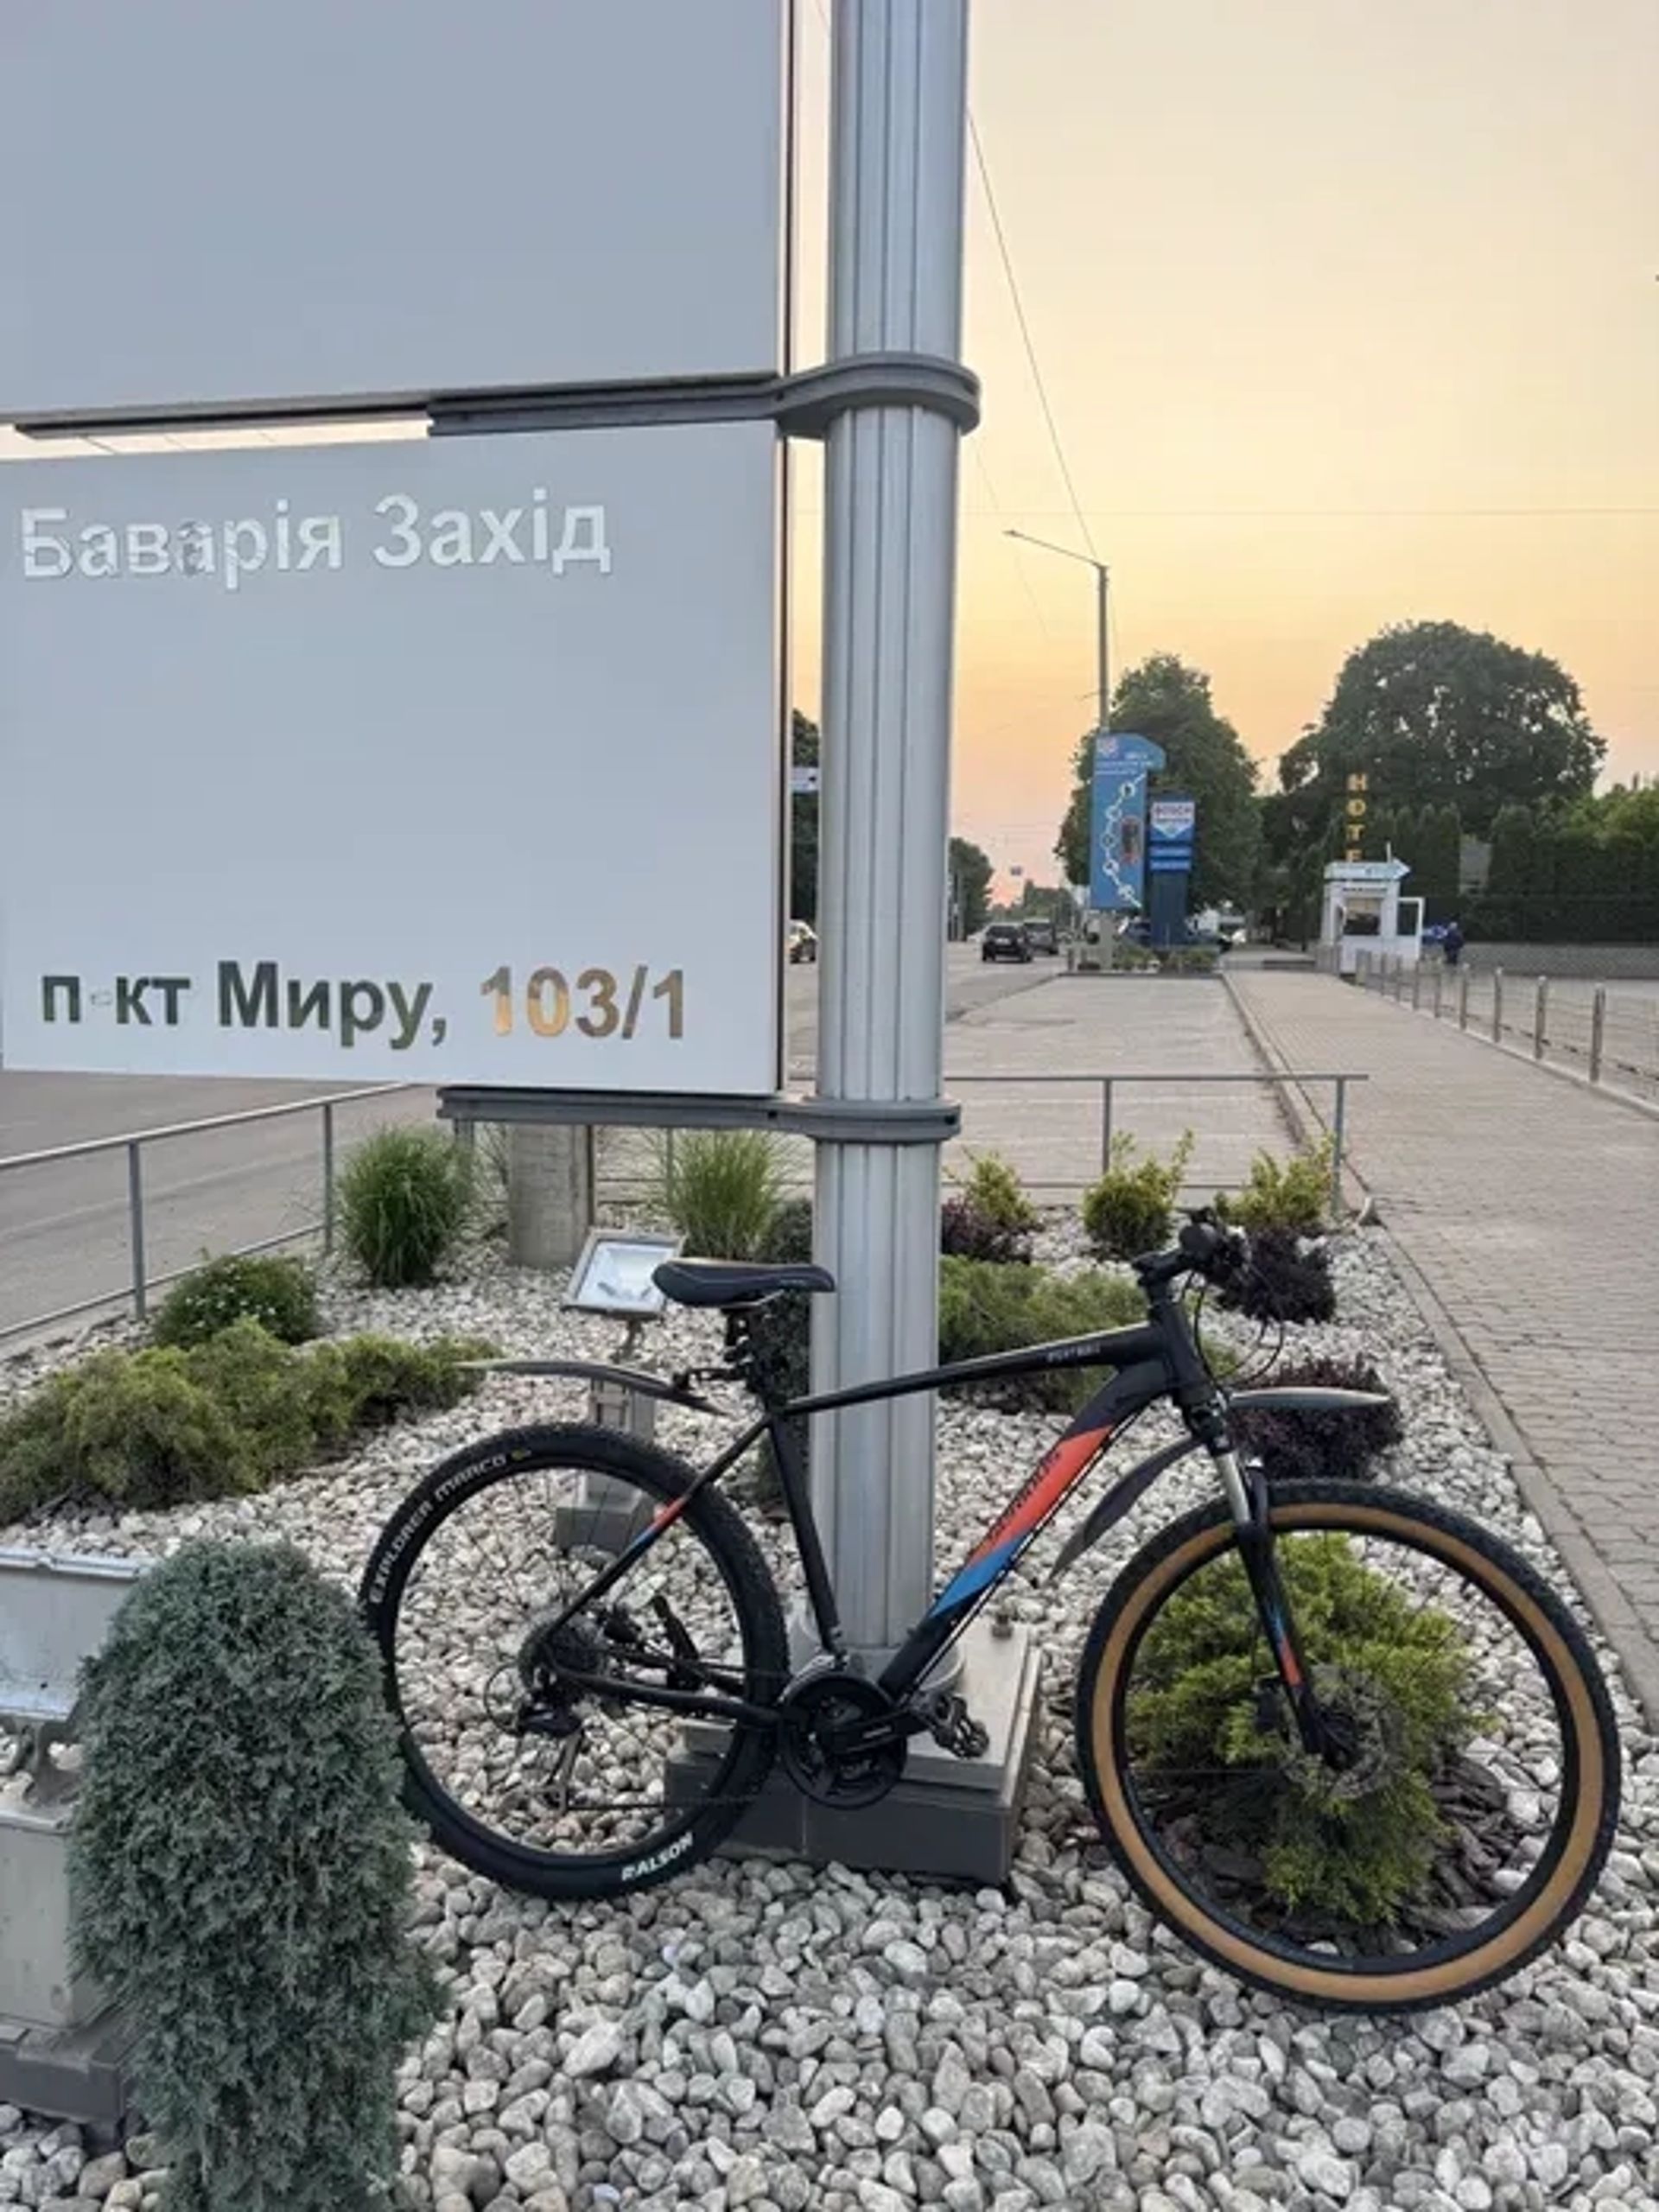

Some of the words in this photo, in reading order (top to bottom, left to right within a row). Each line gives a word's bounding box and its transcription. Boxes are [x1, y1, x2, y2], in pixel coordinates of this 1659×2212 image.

[21, 499, 343, 591] Баварія
[373, 486, 612, 575] Захід
[218, 960, 447, 1050] Миру,
[480, 964, 684, 1039] 103/1
